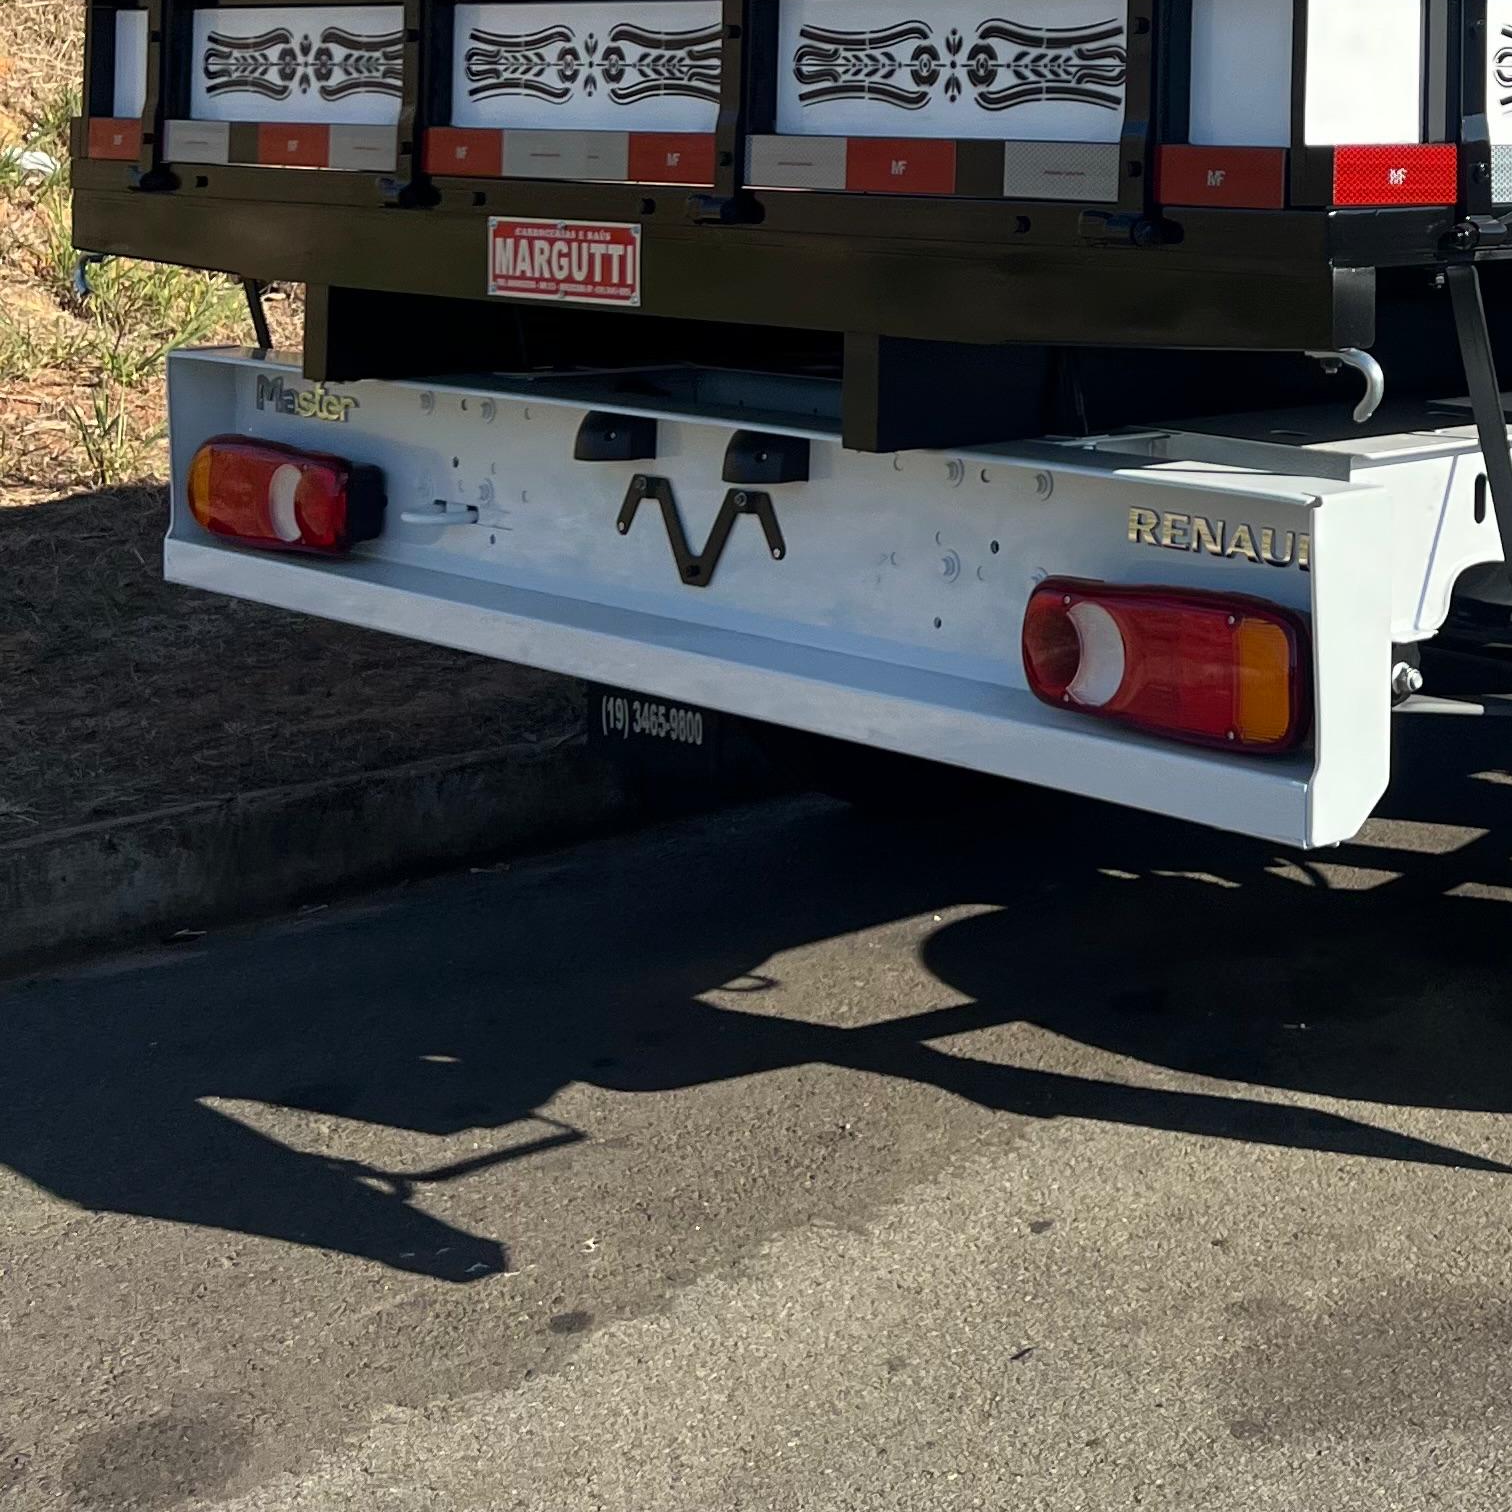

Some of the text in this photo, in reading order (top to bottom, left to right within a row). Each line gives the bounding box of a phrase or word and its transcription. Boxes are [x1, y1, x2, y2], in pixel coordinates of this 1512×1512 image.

[495, 237, 634, 285] MARGUTTI
[256, 374, 360, 423] Master
[602, 695, 703, 745] (19) 3465-9800
